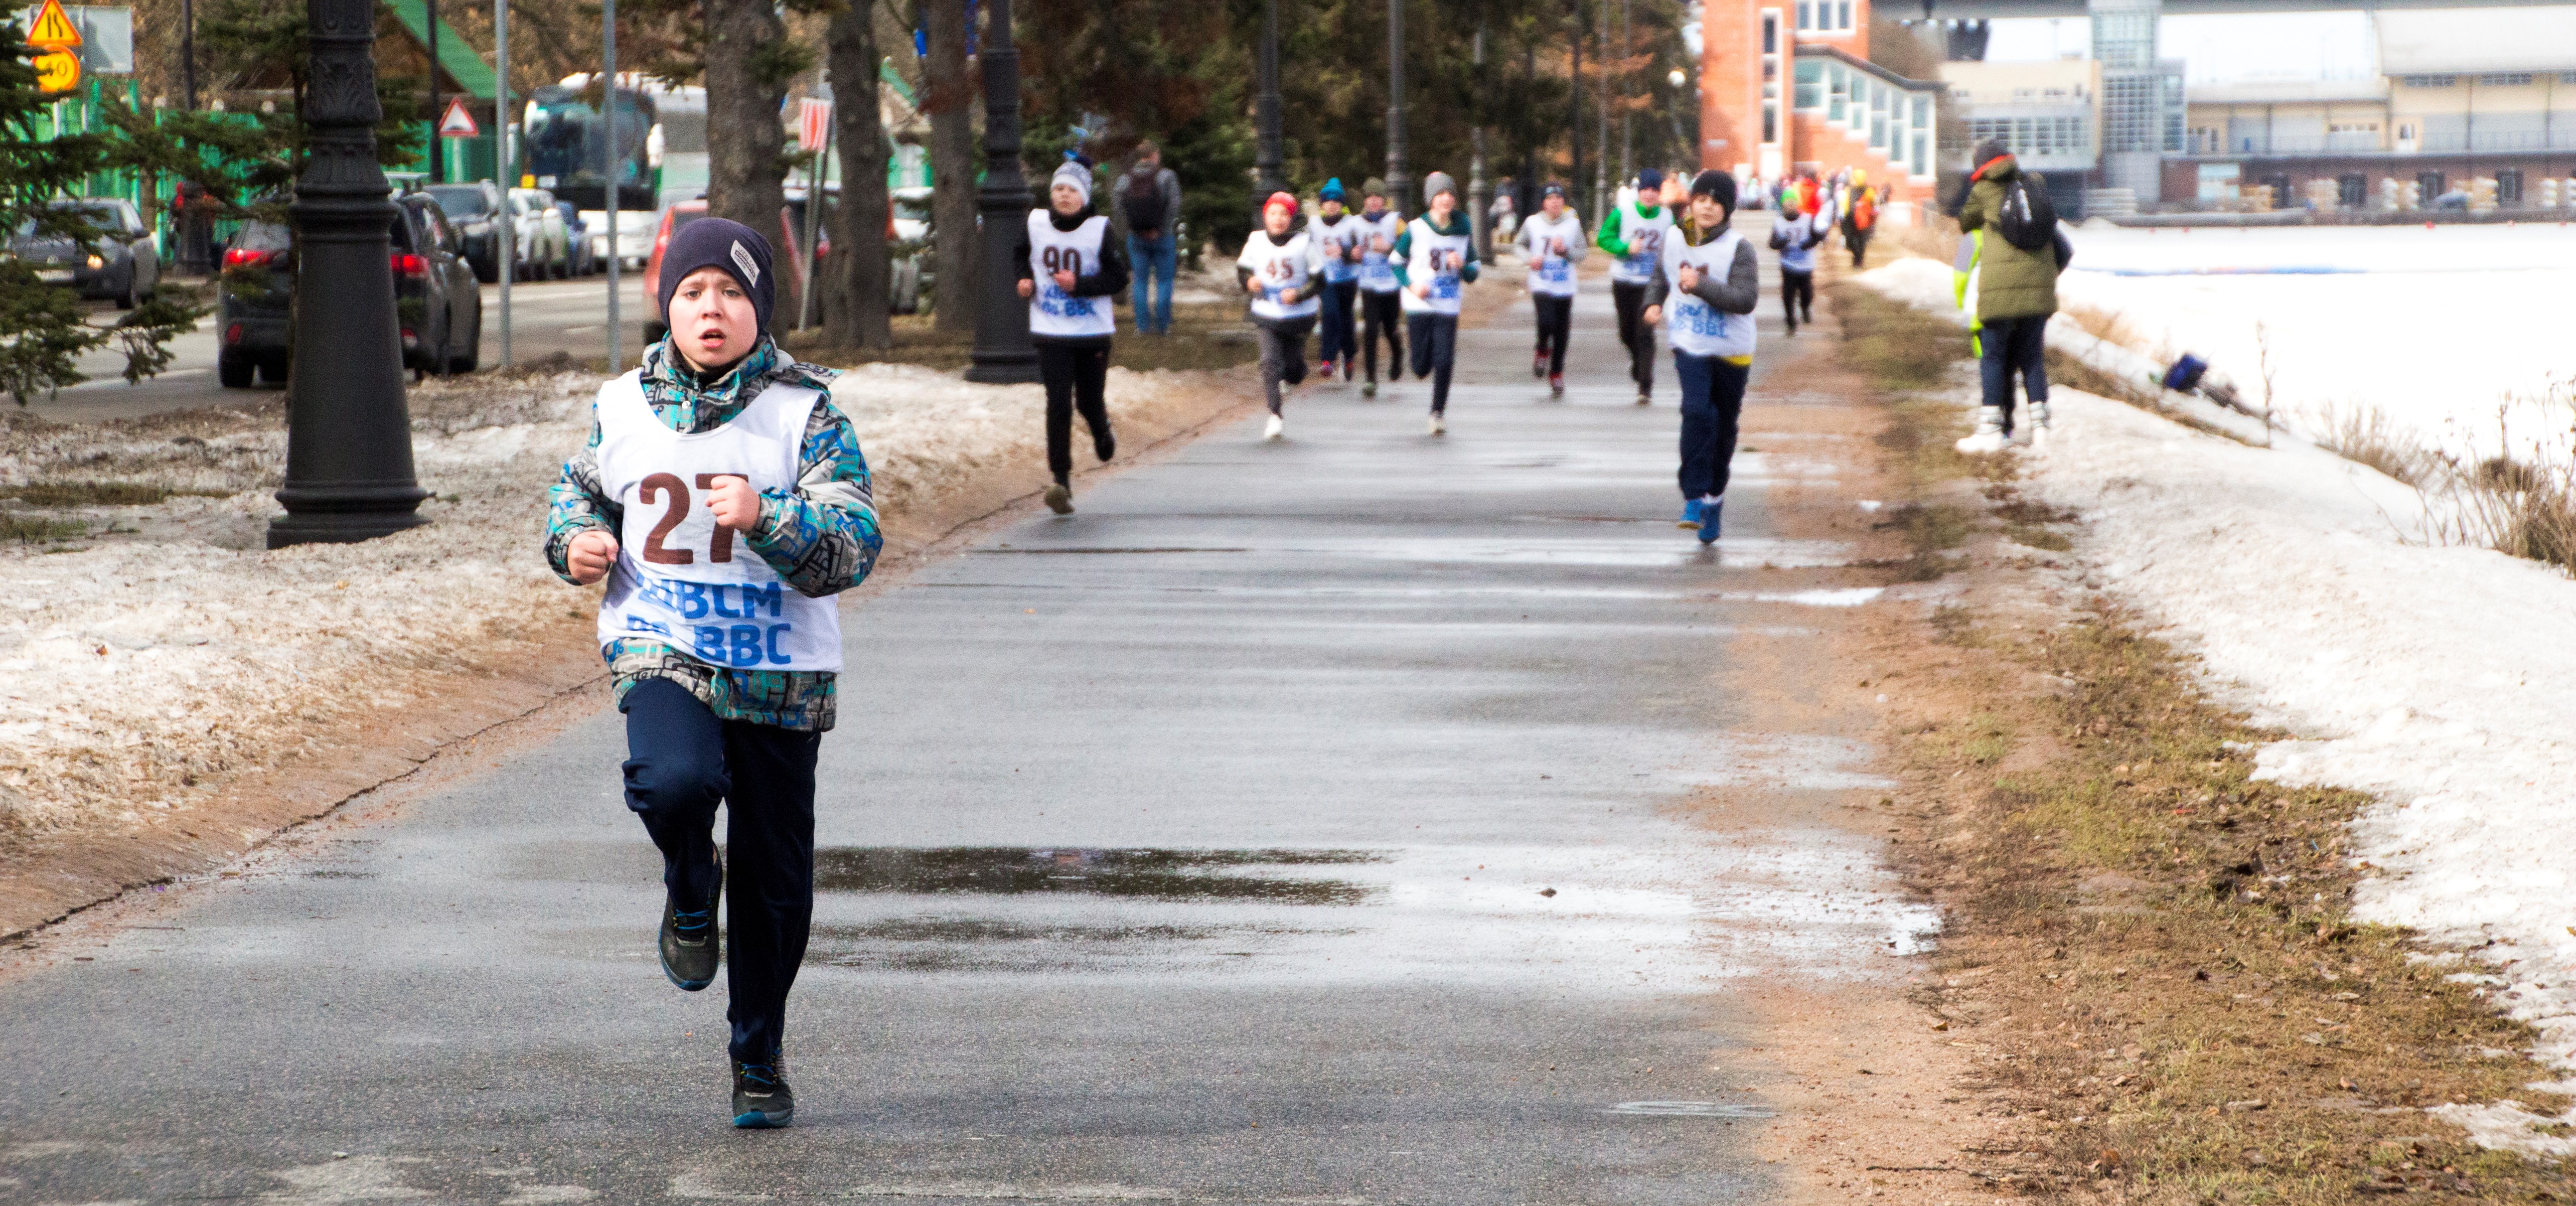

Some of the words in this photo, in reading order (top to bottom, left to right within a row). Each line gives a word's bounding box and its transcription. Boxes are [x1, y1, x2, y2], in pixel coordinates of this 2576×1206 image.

[1043, 245, 1081, 277] 90
[1266, 258, 1294, 280] 45
[639, 472, 749, 565] 27
[693, 623, 791, 667] ВВС
